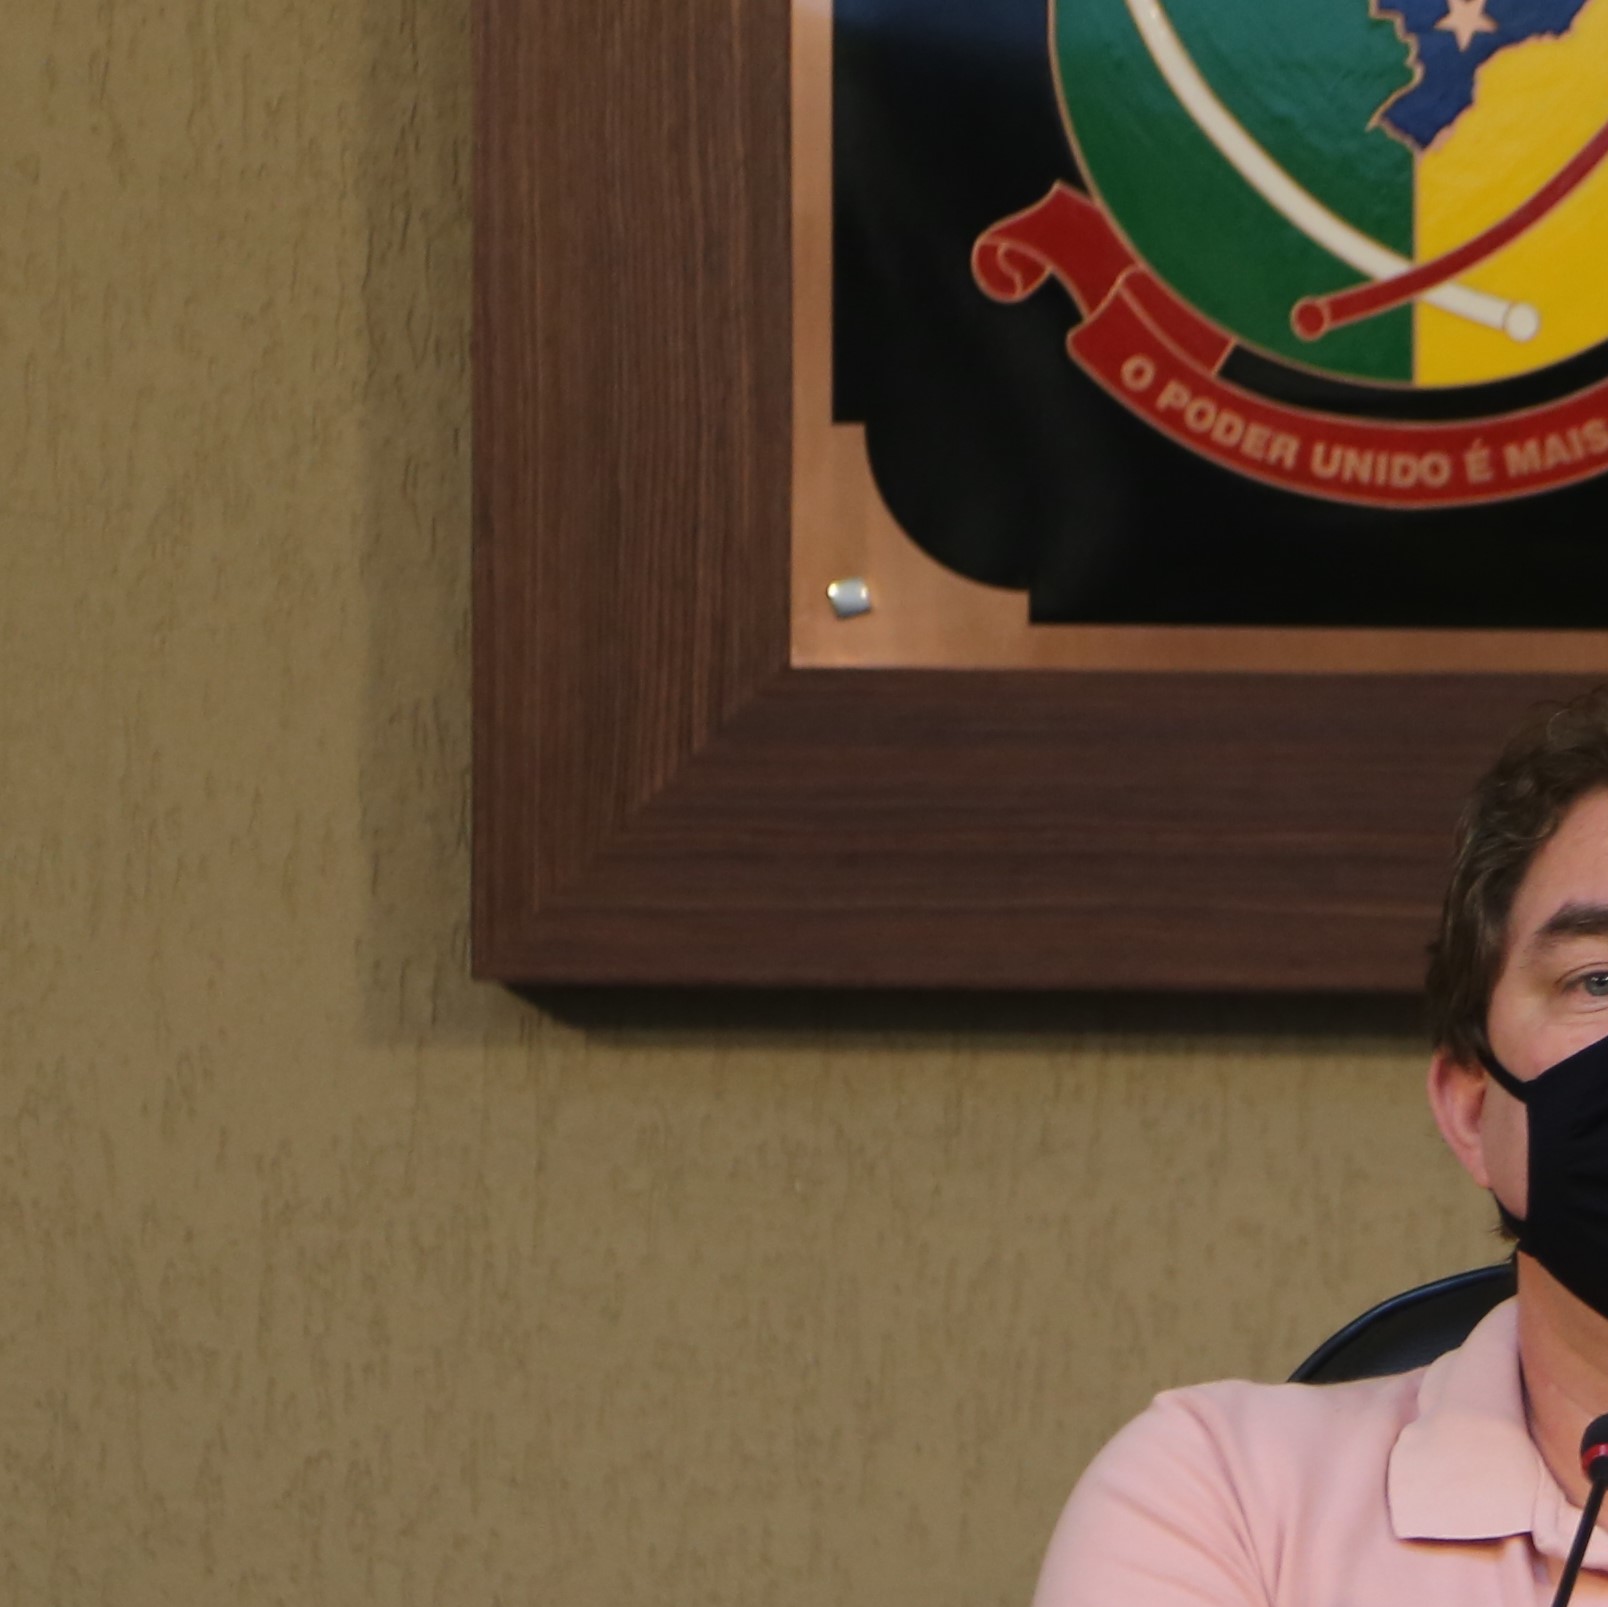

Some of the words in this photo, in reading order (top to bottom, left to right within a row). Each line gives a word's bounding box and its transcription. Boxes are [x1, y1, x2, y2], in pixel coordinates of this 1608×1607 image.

[1120, 354, 1156, 391] O
[1156, 381, 1301, 471] PODER
[1309, 445, 1452, 487] UNIDO
[1464, 440, 1493, 485] É
